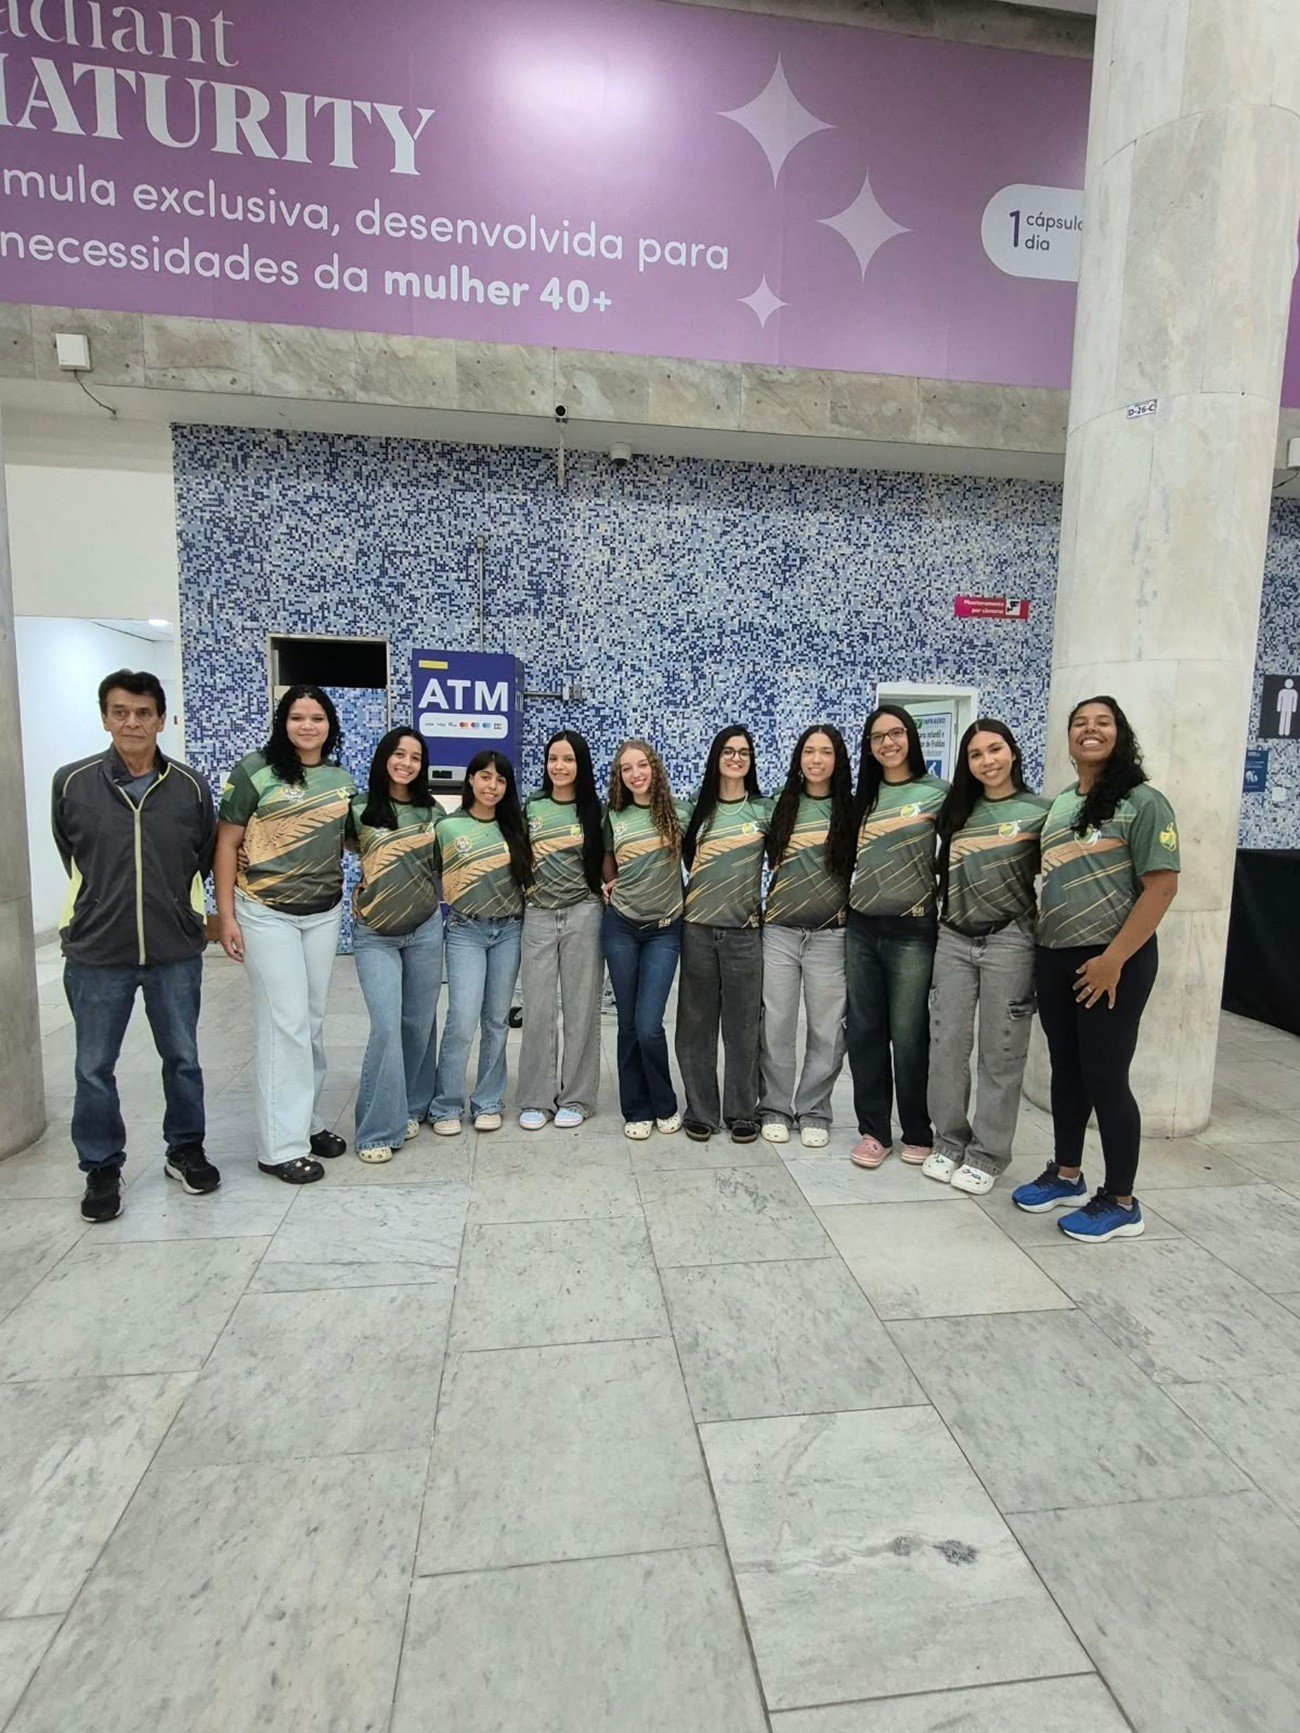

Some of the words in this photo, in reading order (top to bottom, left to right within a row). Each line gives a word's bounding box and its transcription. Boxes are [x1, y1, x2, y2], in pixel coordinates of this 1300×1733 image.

[4, 164, 116, 207] mula
[133, 179, 340, 236] exclusiva,
[356, 198, 623, 260] desenvolvida
[639, 238, 729, 272] para
[1009, 210, 1020, 248] 1
[1025, 234, 1050, 251] dia
[0, 231, 299, 286] necessidades
[315, 253, 368, 294] da
[385, 264, 530, 307] mulher
[540, 277, 613, 313] 40+
[418, 678, 509, 712] ATM
